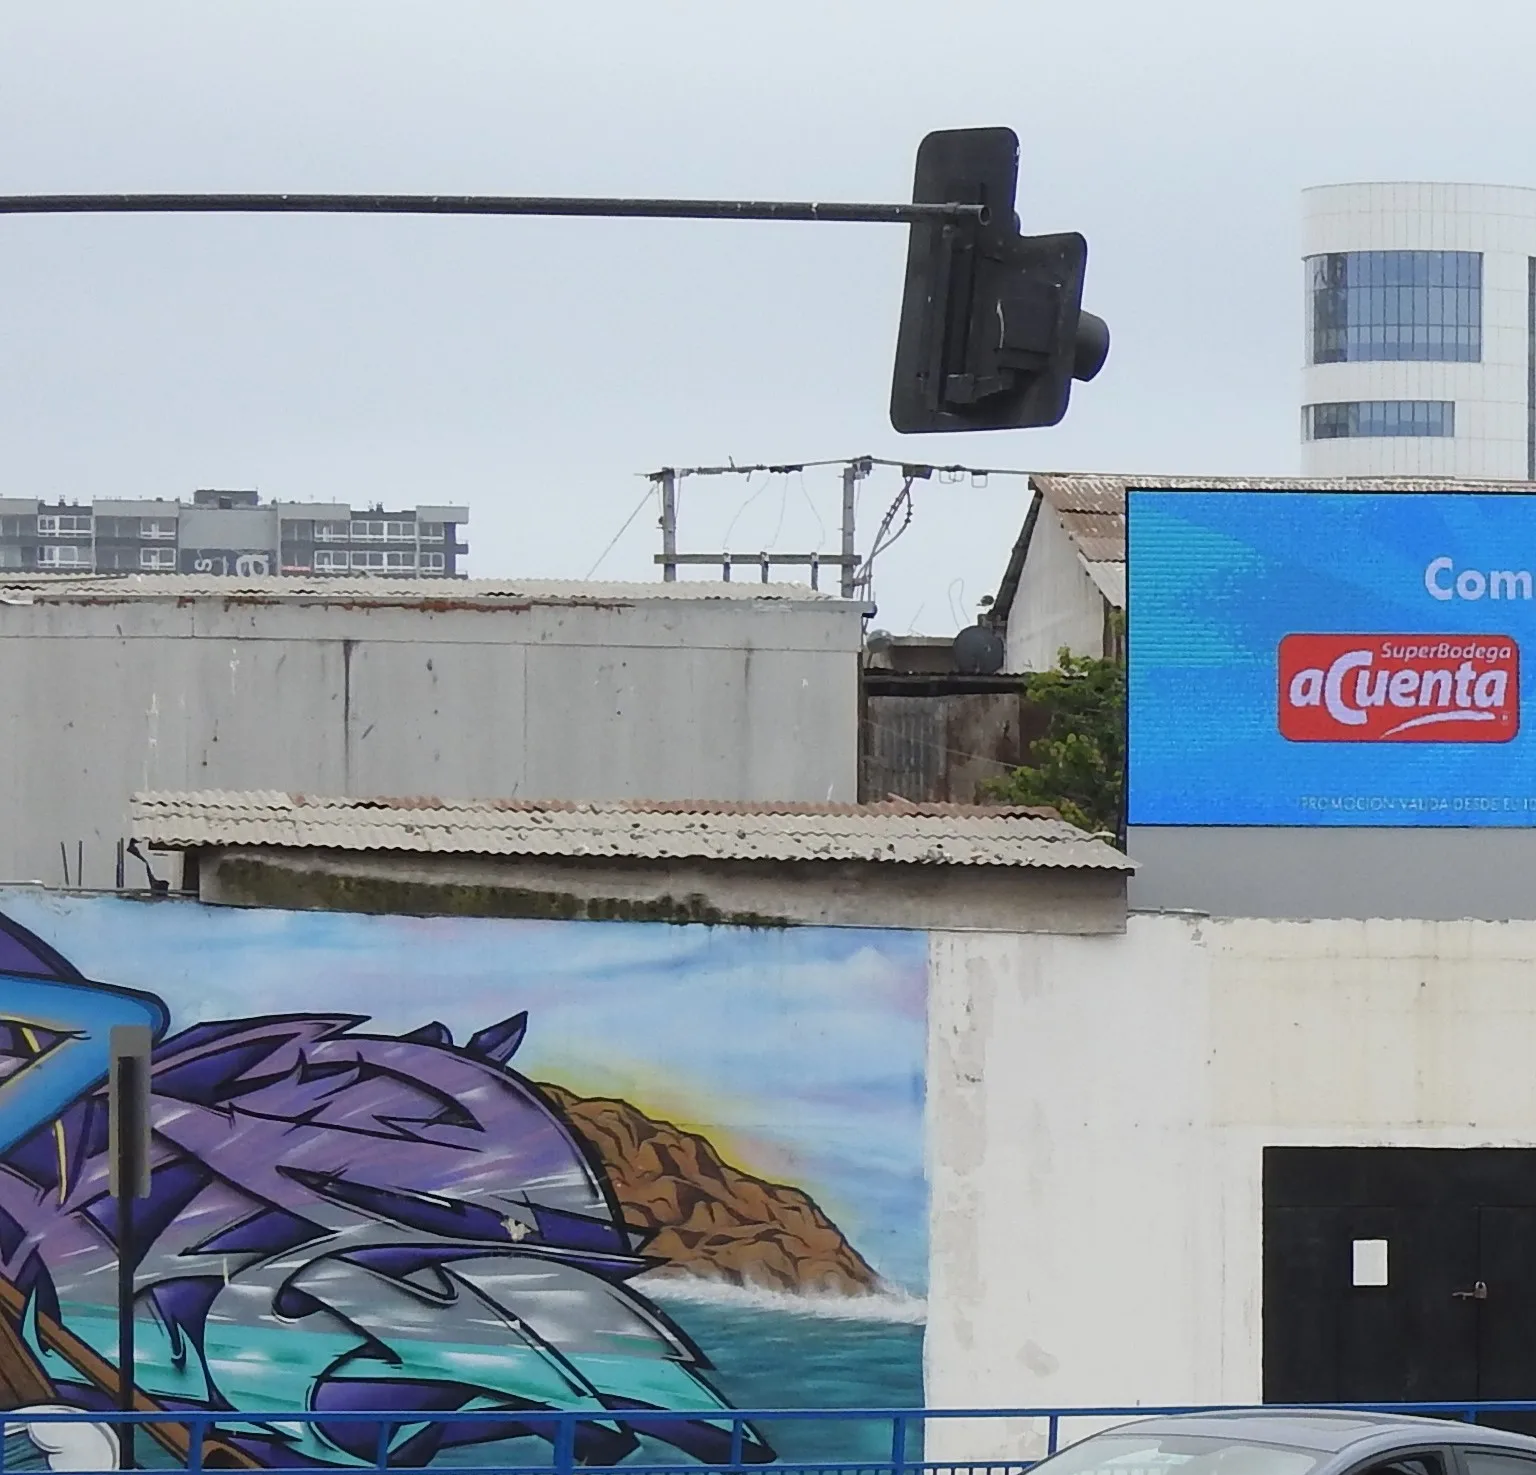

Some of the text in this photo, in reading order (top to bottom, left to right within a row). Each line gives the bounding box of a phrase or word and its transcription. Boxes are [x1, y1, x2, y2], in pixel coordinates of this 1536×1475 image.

[1380, 641, 1511, 664] SuperBodega
[1289, 650, 1508, 725] aCuenta
[1453, 797, 1501, 811] DESDE
